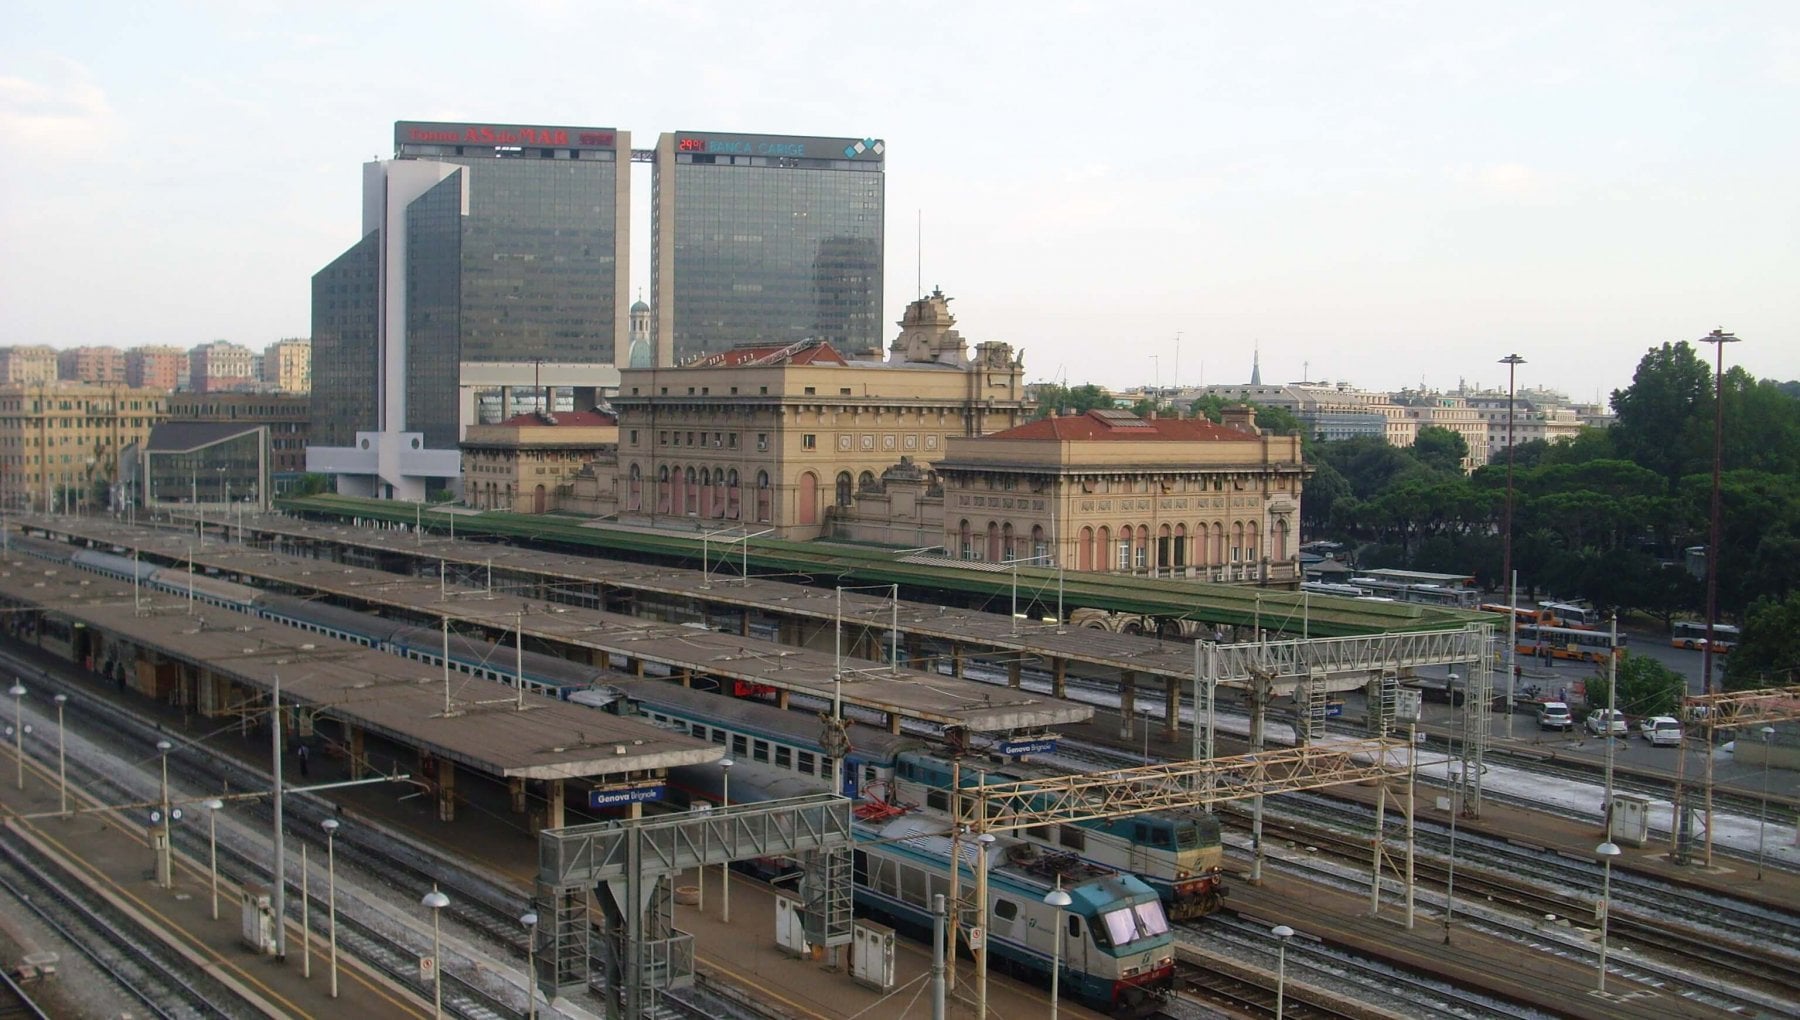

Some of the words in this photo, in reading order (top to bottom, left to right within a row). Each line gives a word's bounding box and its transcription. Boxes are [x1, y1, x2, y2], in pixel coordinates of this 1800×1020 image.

[711, 141, 752, 153] BANCA
[1005, 745, 1031, 754] Genova
[598, 793, 630, 804] Genova
[630, 789, 657, 800] Brignole
